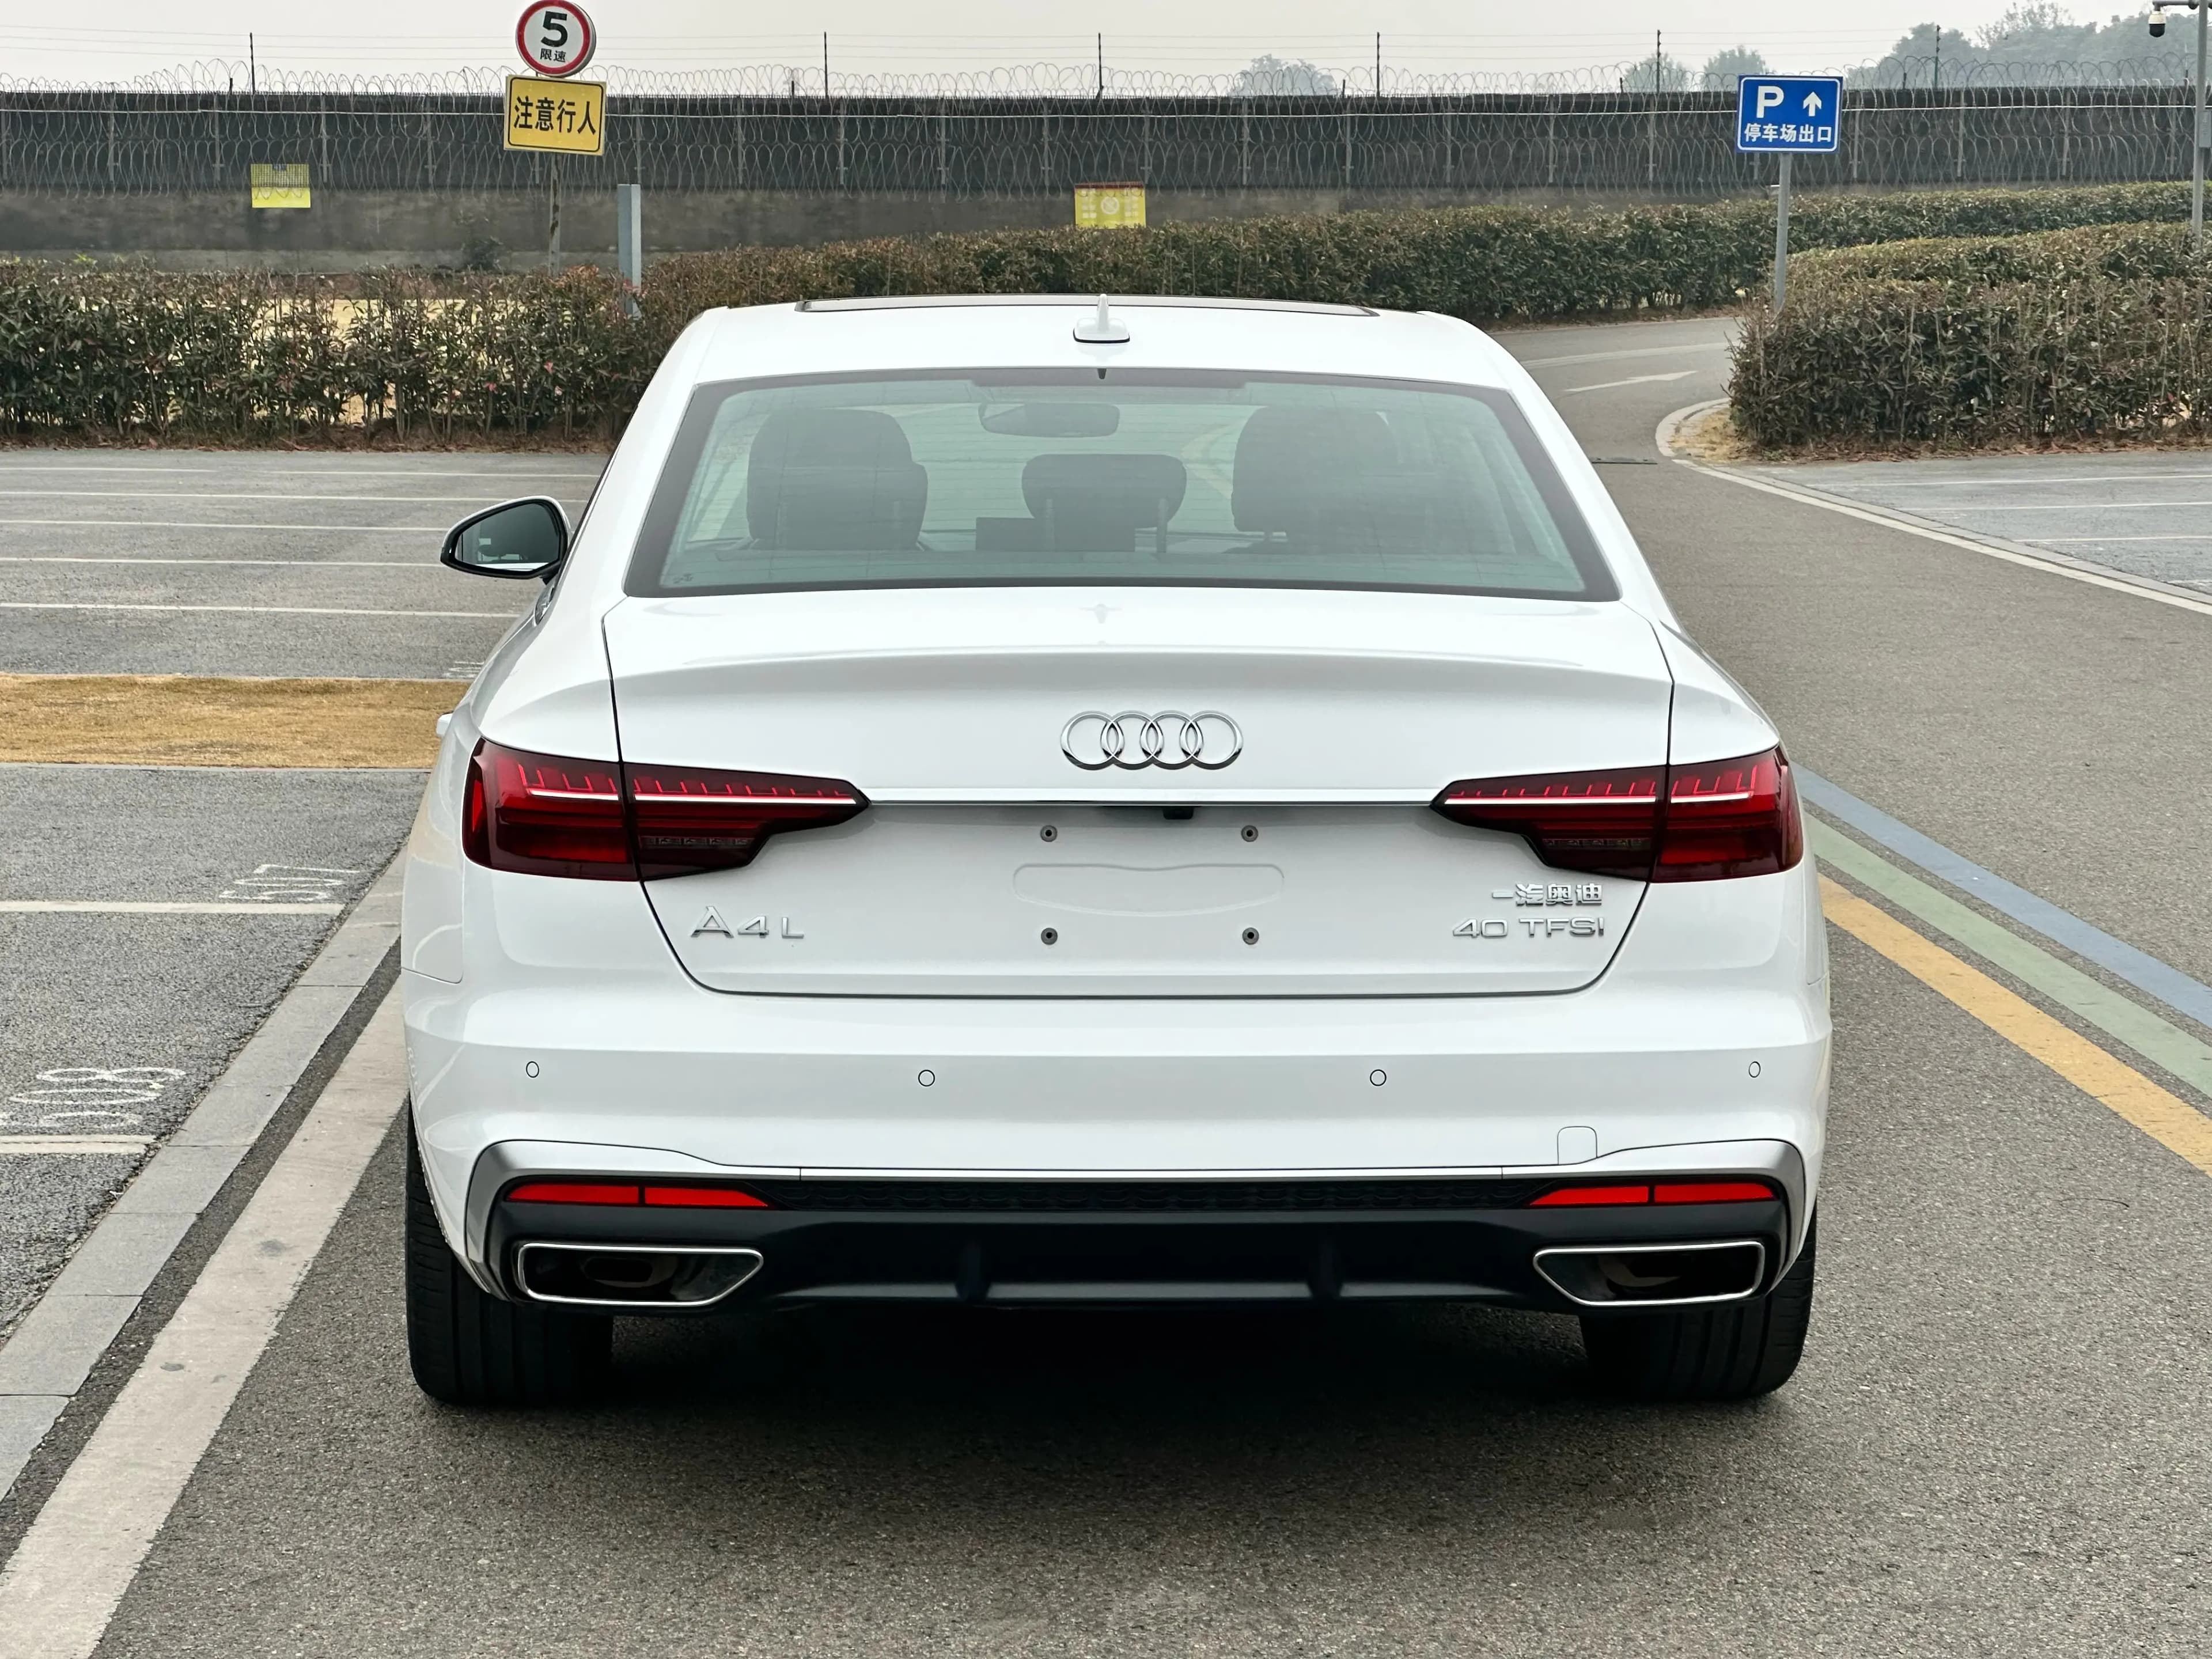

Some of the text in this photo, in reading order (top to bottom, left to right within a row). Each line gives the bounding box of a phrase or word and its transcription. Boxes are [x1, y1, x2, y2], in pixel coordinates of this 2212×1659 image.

[540, 11, 569, 47] 5
[540, 48, 567, 63] 限速
[1756, 85, 1785, 119] P
[514, 95, 596, 135] 注意行人
[1744, 123, 1832, 143] 停车场出口
[1491, 882, 1603, 906] 一汽奥迪
[1452, 916, 1605, 938] 40 TFSI
